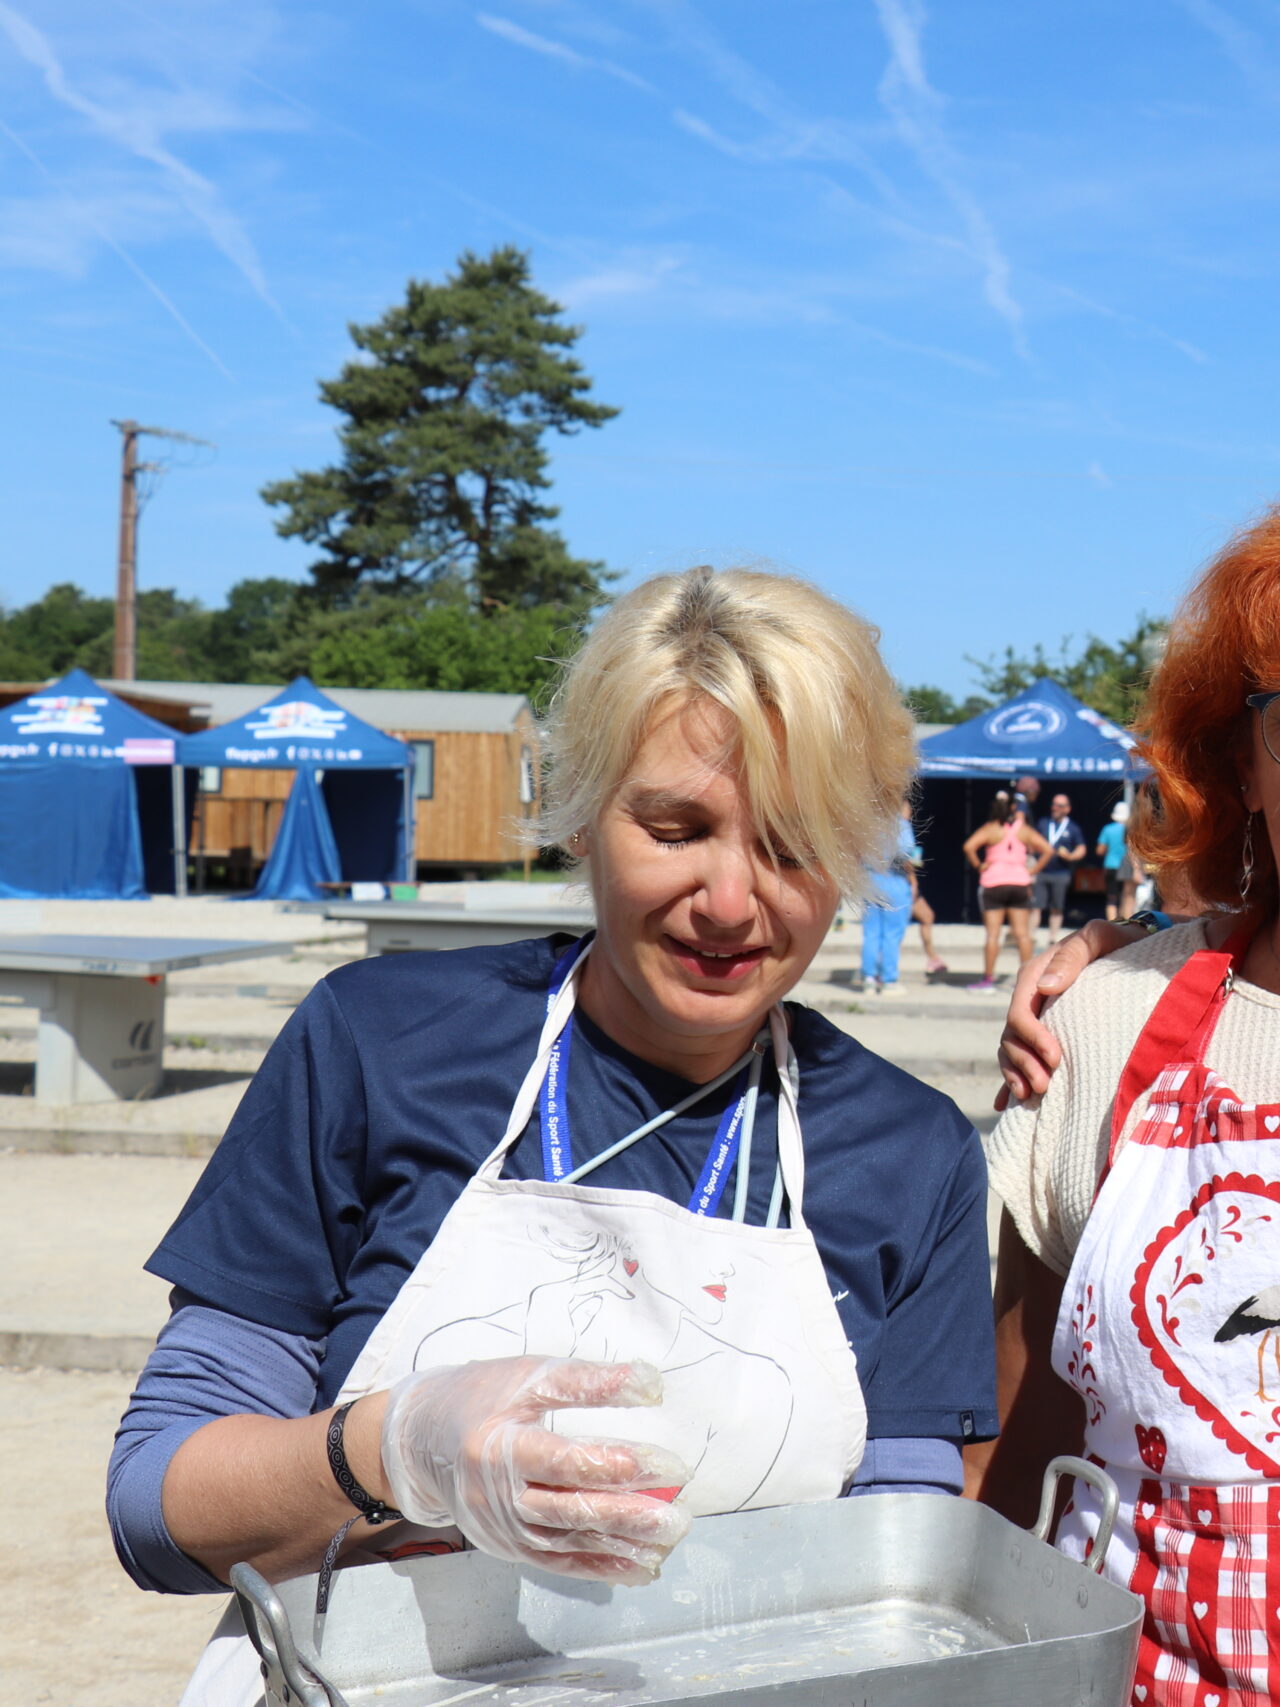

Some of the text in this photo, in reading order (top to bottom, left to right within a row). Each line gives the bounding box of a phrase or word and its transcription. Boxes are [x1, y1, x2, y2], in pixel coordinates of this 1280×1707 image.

[547, 1101, 557, 1114] du
[548, 1116, 560, 1145] Sport
[551, 1146, 564, 1177] Santé
[713, 1143, 730, 1171] Santé
[703, 1170, 720, 1195] Sport
[699, 1198, 710, 1209] du
